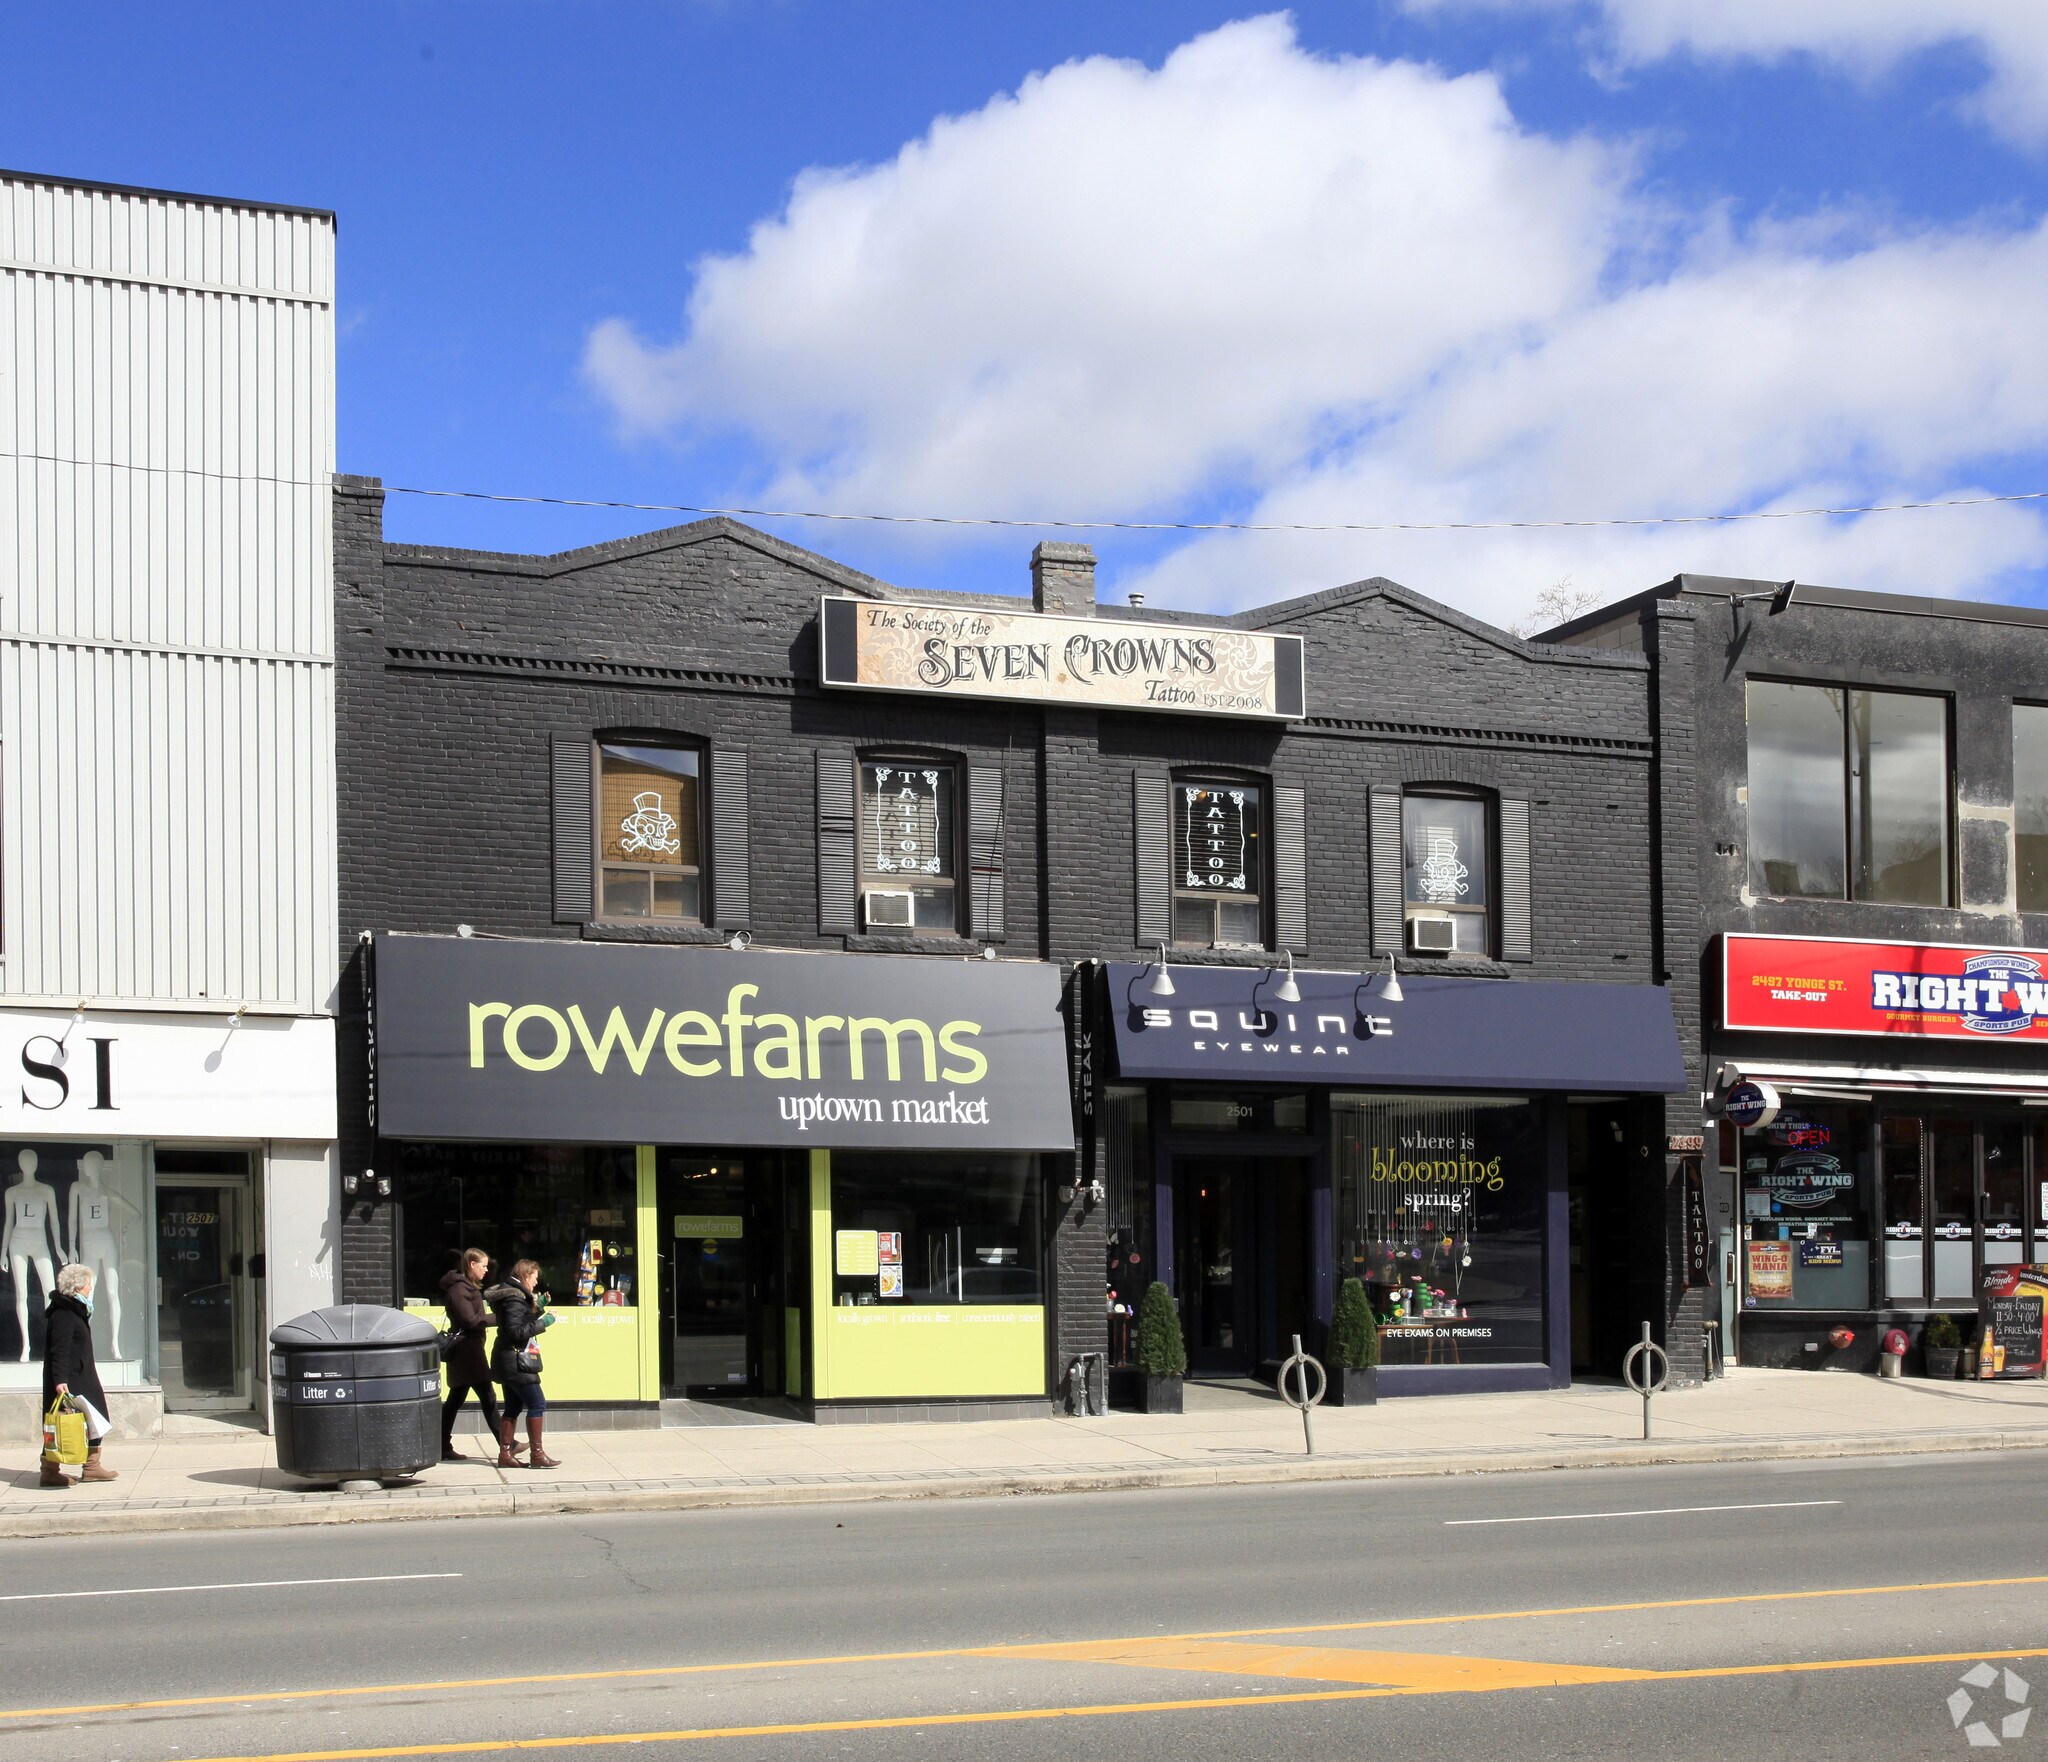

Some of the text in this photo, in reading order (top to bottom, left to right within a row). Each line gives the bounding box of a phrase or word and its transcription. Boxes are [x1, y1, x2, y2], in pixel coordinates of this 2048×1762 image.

[867, 609, 991, 636] The Society of the
[918, 633, 1217, 688] SEVEN CROWNS
[1144, 679, 1197, 704] Tattoo
[898, 771, 918, 870] TATTOO
[1206, 791, 1226, 887] TATTOO
[1967, 958, 2010, 971] CHAMPIONSHIP
[1988, 969, 2010, 980] THE
[1751, 975, 1848, 992] 2497 YONGE ST.
[1770, 989, 1828, 1002] TAKE-OUT
[1872, 973, 2009, 1013] RIGHT
[1886, 1012, 1920, 1022] GOURMET
[1922, 1013, 1957, 1023] BURGERS
[1973, 1016, 2031, 1030] SPORTS PUB
[469, 983, 989, 1085] rowefarms
[1194, 1041, 1349, 1055] EYEWEAR
[0, 1035, 121, 1111] SI
[1083, 1031, 1093, 1116] STEAK
[1740, 1094, 1750, 1102] THE
[777, 1090, 990, 1130] uptown market
[1226, 1105, 1253, 1117] 2501
[1725, 1099, 1767, 1112] RIGHT WING
[1400, 1131, 1475, 1150] where is
[1671, 1136, 1704, 1149] 2499
[1788, 1130, 1832, 1145] OPEN
[1371, 1147, 1505, 1192] blooming
[1796, 1166, 1814, 1174] THE
[1761, 1175, 1853, 1187] RIGHT WING
[1404, 1187, 1472, 1213] spring?
[1784, 1193, 1814, 1201] SPORTS
[188, 1213, 214, 1223] 2507
[678, 1219, 740, 1232] rowefarms
[1691, 1190, 1704, 1269] TATTOO
[1752, 1254, 1788, 1263] WING-O
[1752, 1263, 1788, 1271] MANIA
[1983, 1274, 2014, 1288] Blonde
[607, 1315, 635, 1328] grown
[862, 1315, 888, 1325] grown
[1386, 1327, 1493, 1338] EYE EXAMS ON PREMISES
[2004, 1326, 2022, 1335] PRICE
[274, 1383, 288, 1398] Litter
[302, 1386, 329, 1400] Litter
[423, 1379, 437, 1393] Litter
